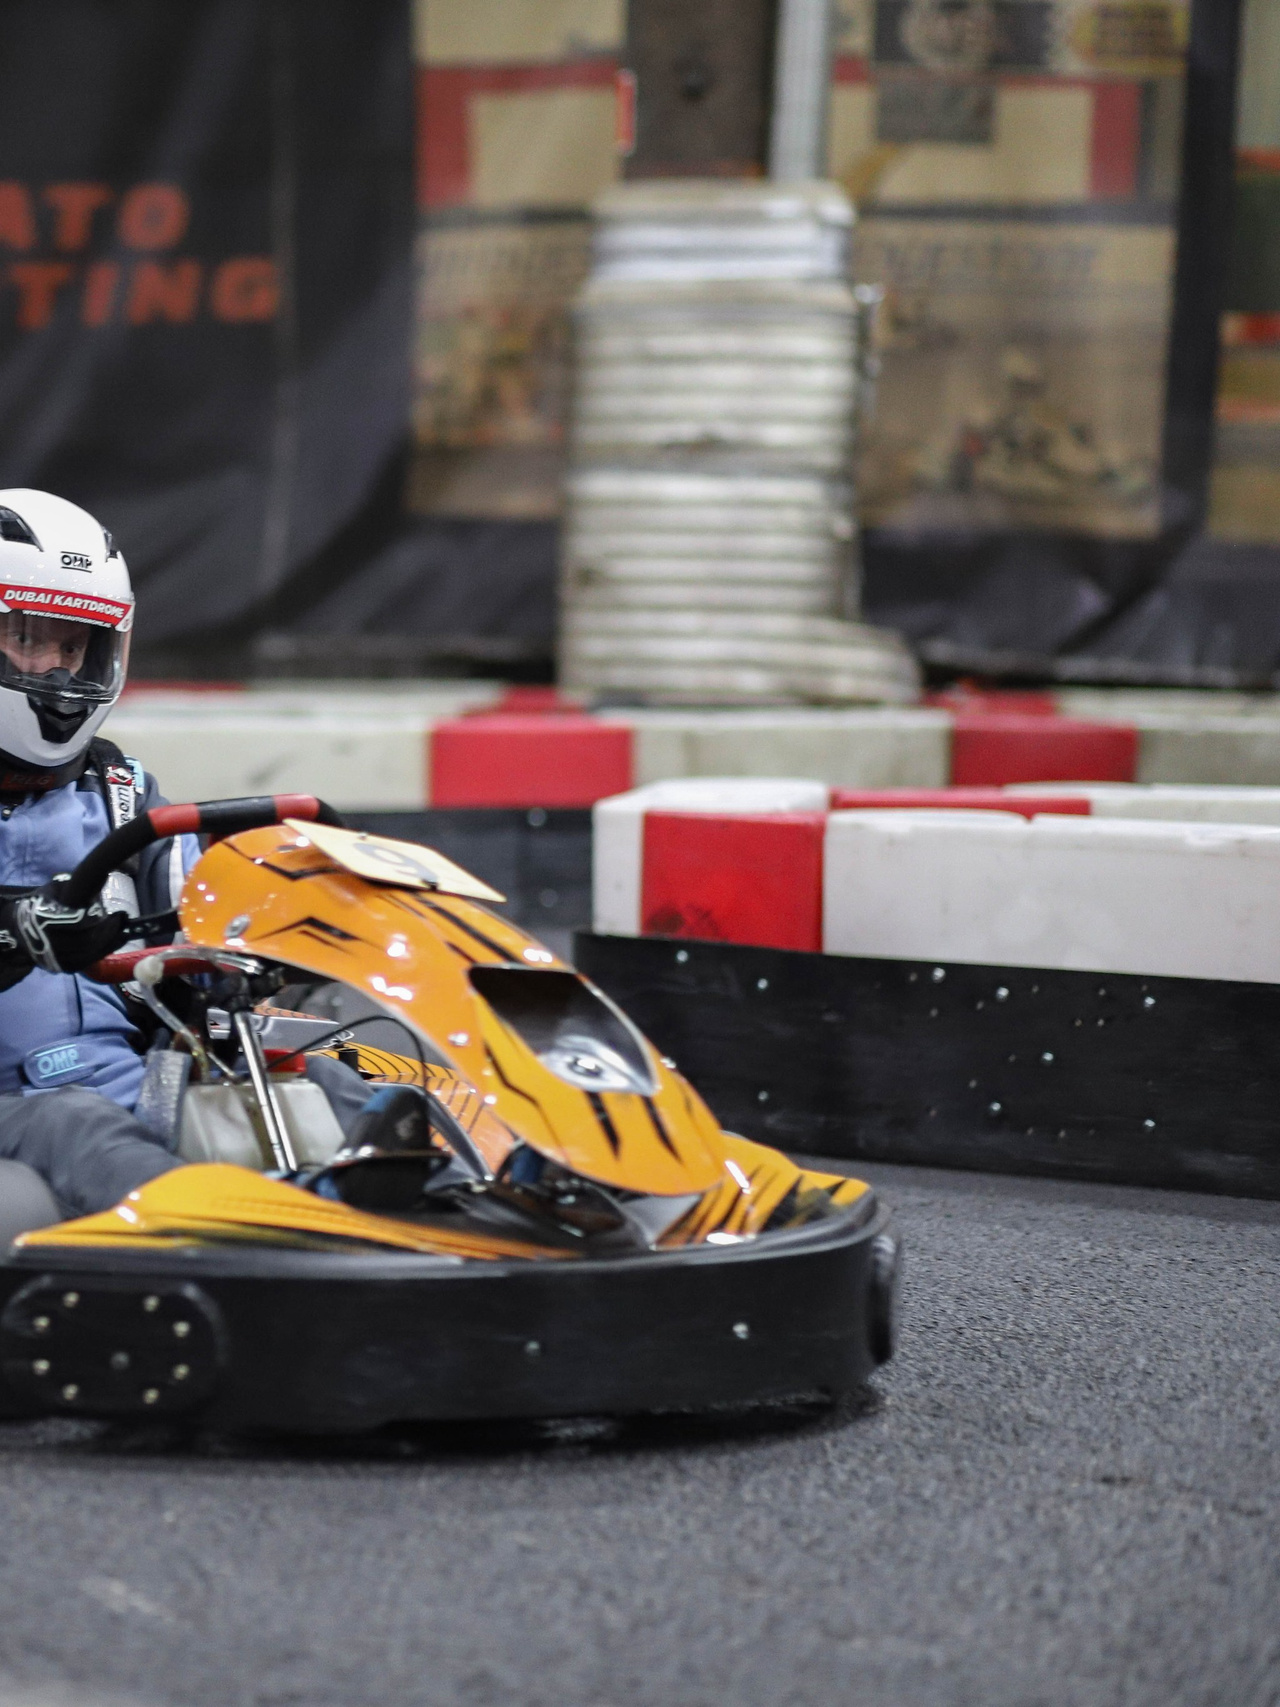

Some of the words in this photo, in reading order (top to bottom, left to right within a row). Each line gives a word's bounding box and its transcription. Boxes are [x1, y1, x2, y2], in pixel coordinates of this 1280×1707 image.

[61, 554, 92, 568] OMP
[4, 590, 51, 604] DUBAI
[52, 595, 124, 618] KARTDROME
[37, 1048, 79, 1075] OMP
